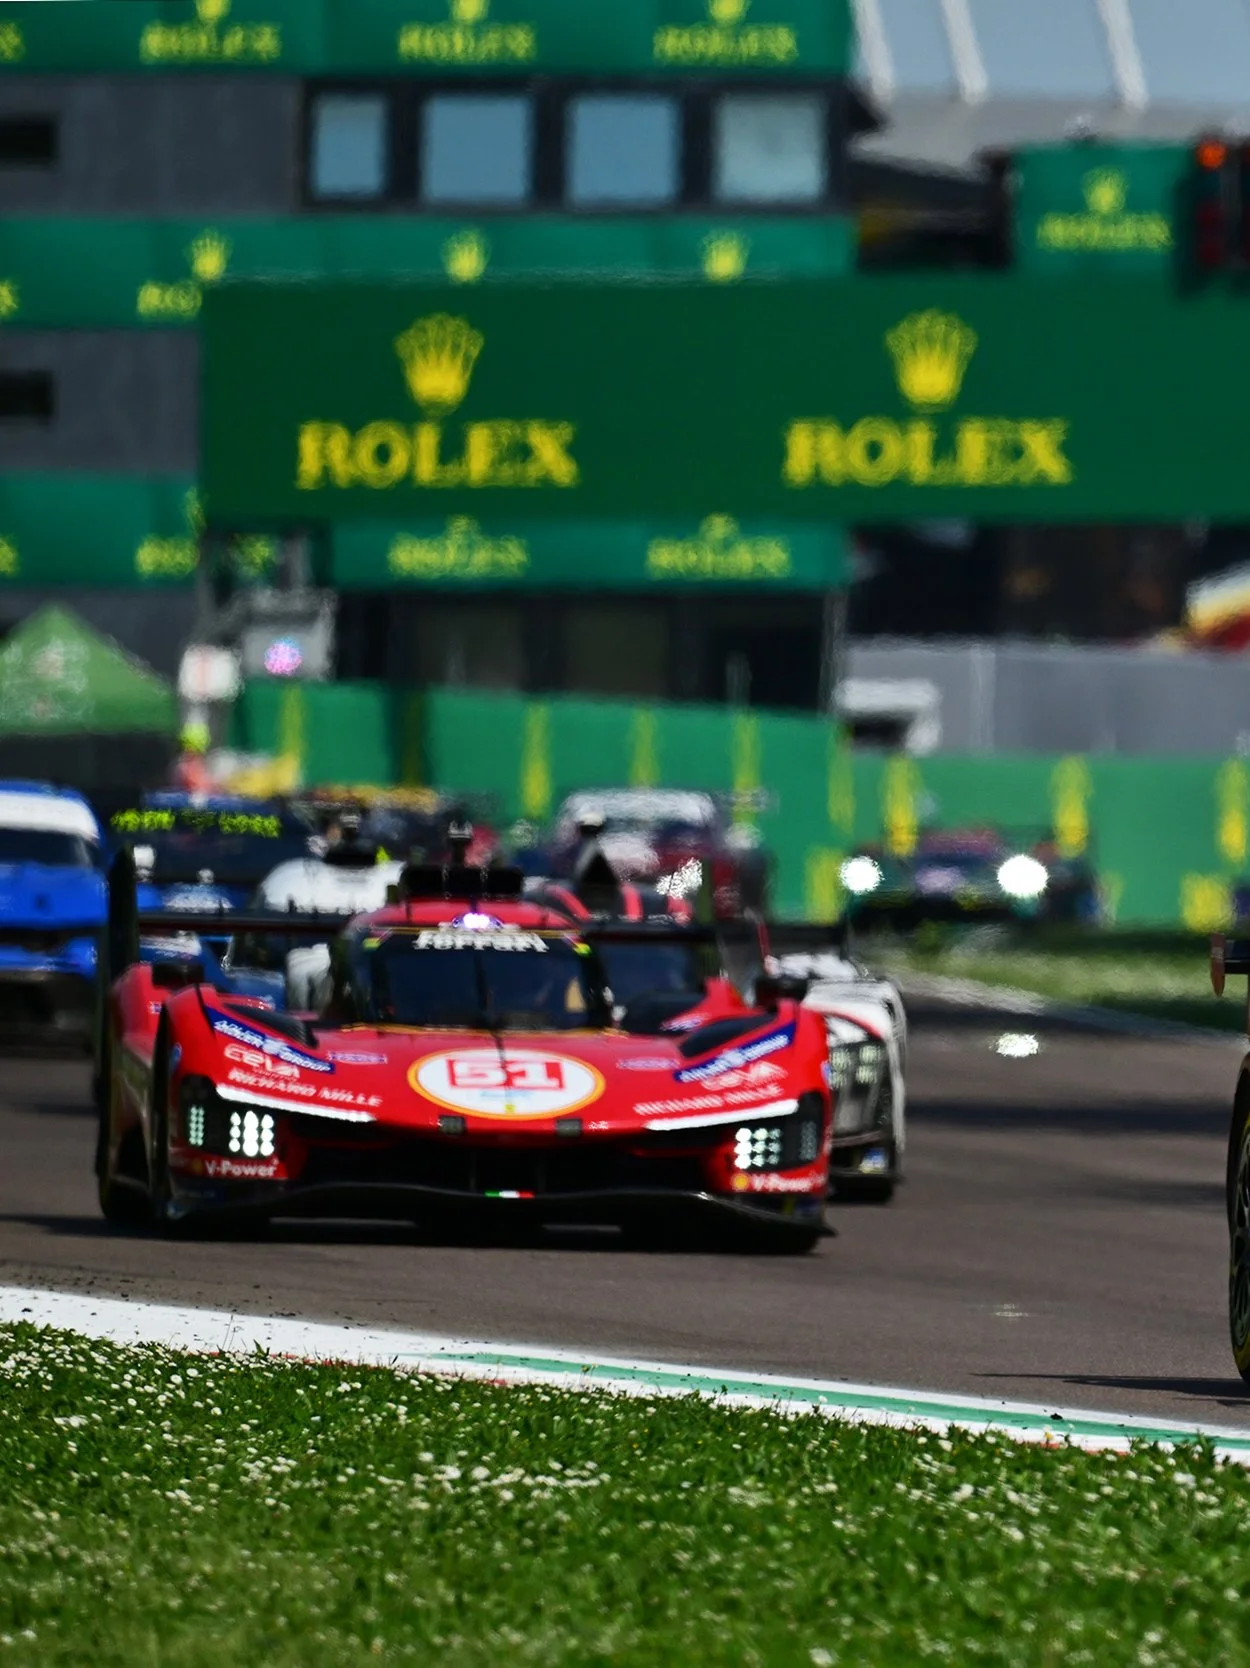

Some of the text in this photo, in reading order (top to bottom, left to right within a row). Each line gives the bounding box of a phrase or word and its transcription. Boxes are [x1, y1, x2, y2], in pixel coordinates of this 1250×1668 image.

[296, 419, 578, 490] ROLEX
[783, 416, 1070, 487] ROLEX
[228, 1067, 317, 1097] RICHARD
[319, 1086, 384, 1107] MILLE
[449, 1060, 562, 1090] 51
[205, 1159, 278, 1178] V-Power
